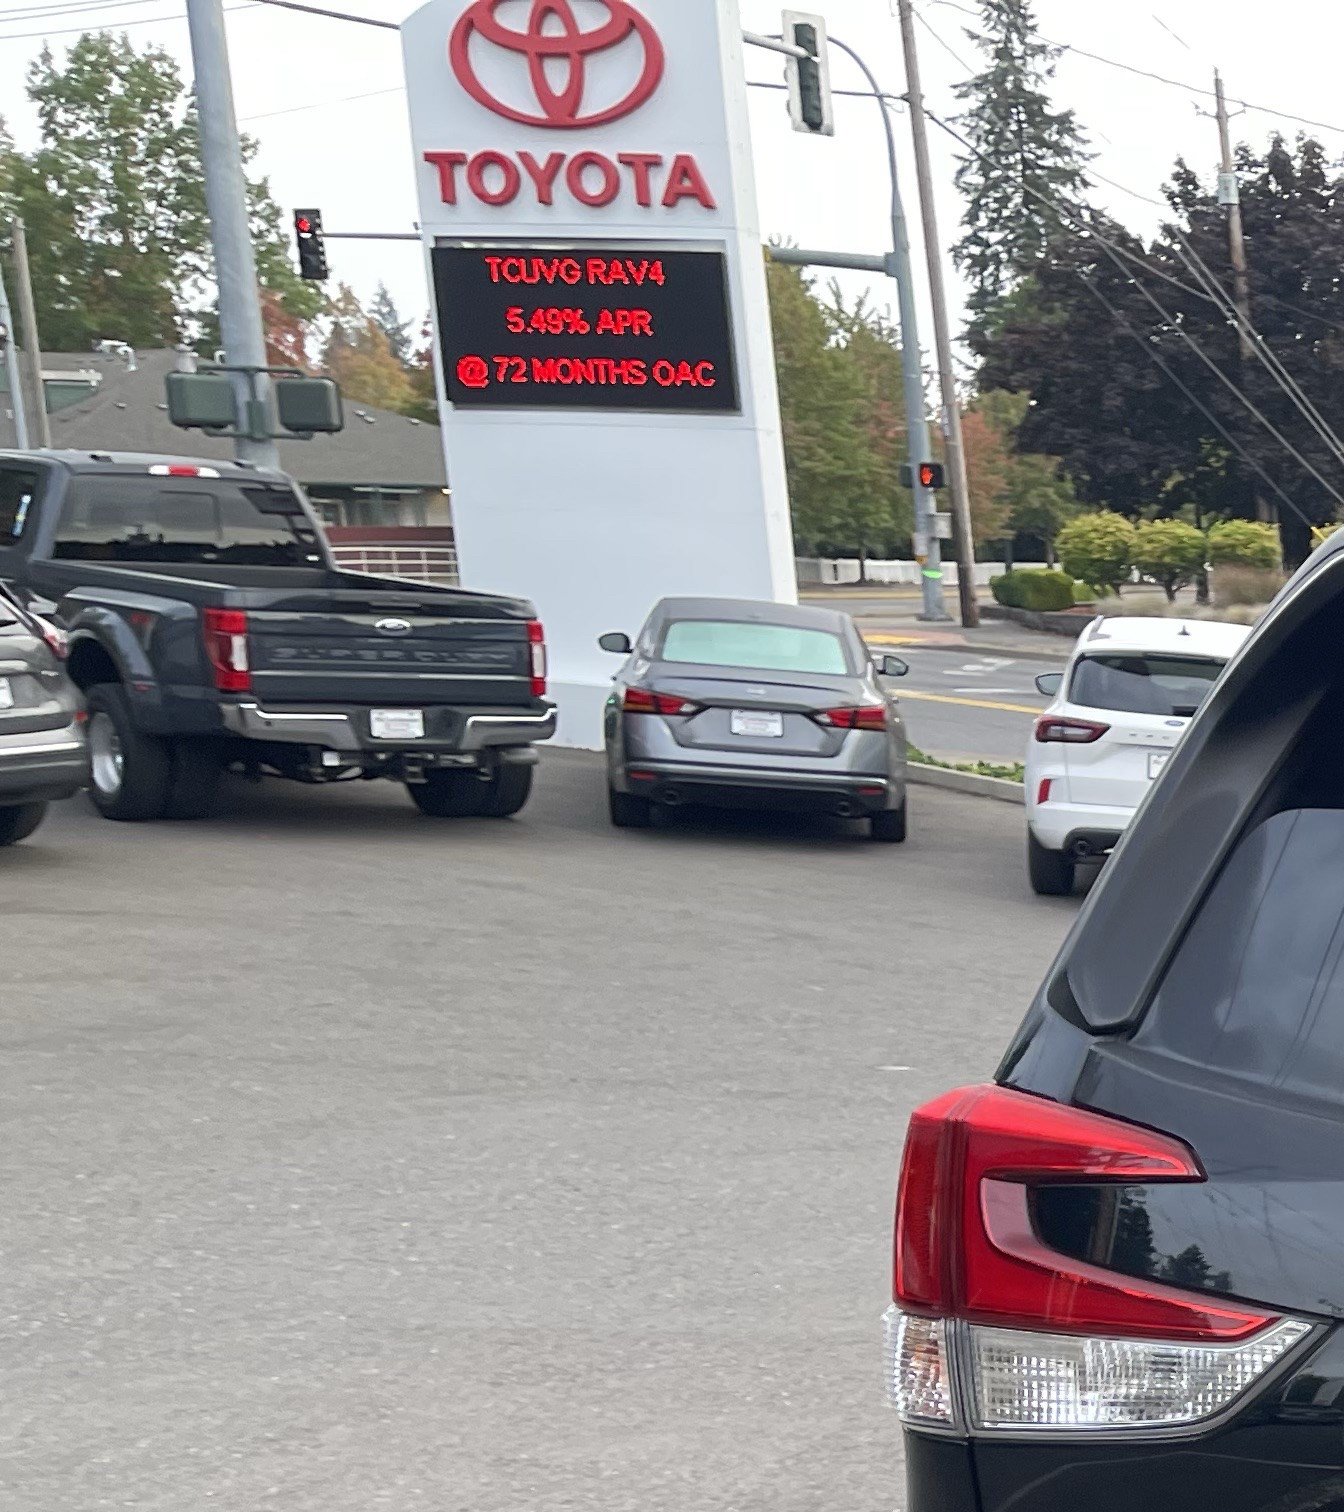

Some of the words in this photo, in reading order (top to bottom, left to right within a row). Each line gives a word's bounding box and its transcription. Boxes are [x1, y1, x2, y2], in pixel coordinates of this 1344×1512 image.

[423, 149, 717, 209] TOYOTA
[485, 256, 582, 285] TCUVG
[588, 258, 665, 286] RAV4
[506, 306, 590, 334] 5.49%
[597, 308, 654, 337] APR
[457, 356, 489, 389] @
[494, 356, 527, 384] 72
[533, 357, 646, 386] MONTHS
[652, 359, 716, 388] OAC
